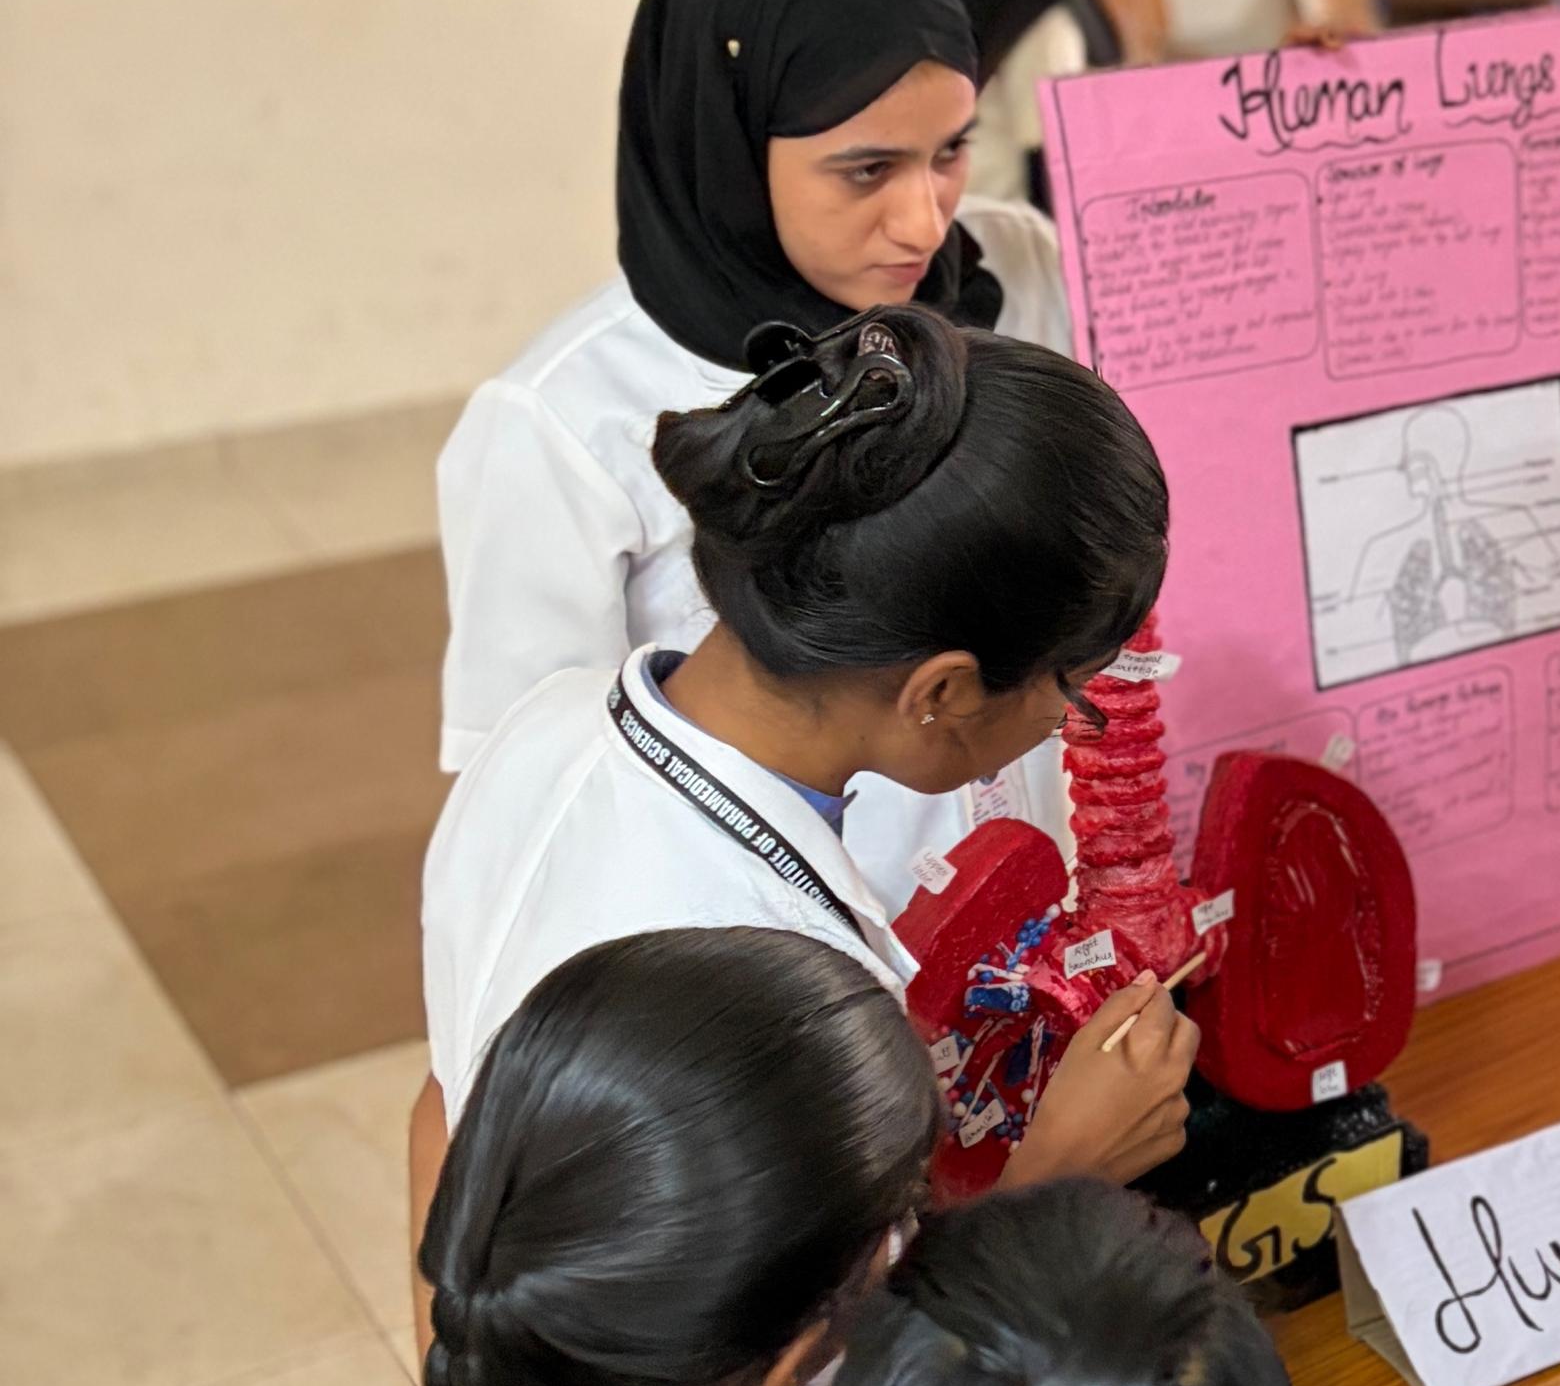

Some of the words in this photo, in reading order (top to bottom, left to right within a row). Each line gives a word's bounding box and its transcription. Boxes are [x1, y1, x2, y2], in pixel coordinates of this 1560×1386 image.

[1219, 49, 1412, 148] Human
[1435, 29, 1556, 128] Lungs
[620, 709, 672, 765] SCIENCES
[664, 755, 760, 840] PARAMEDICAL
[751, 832, 777, 854] OF
